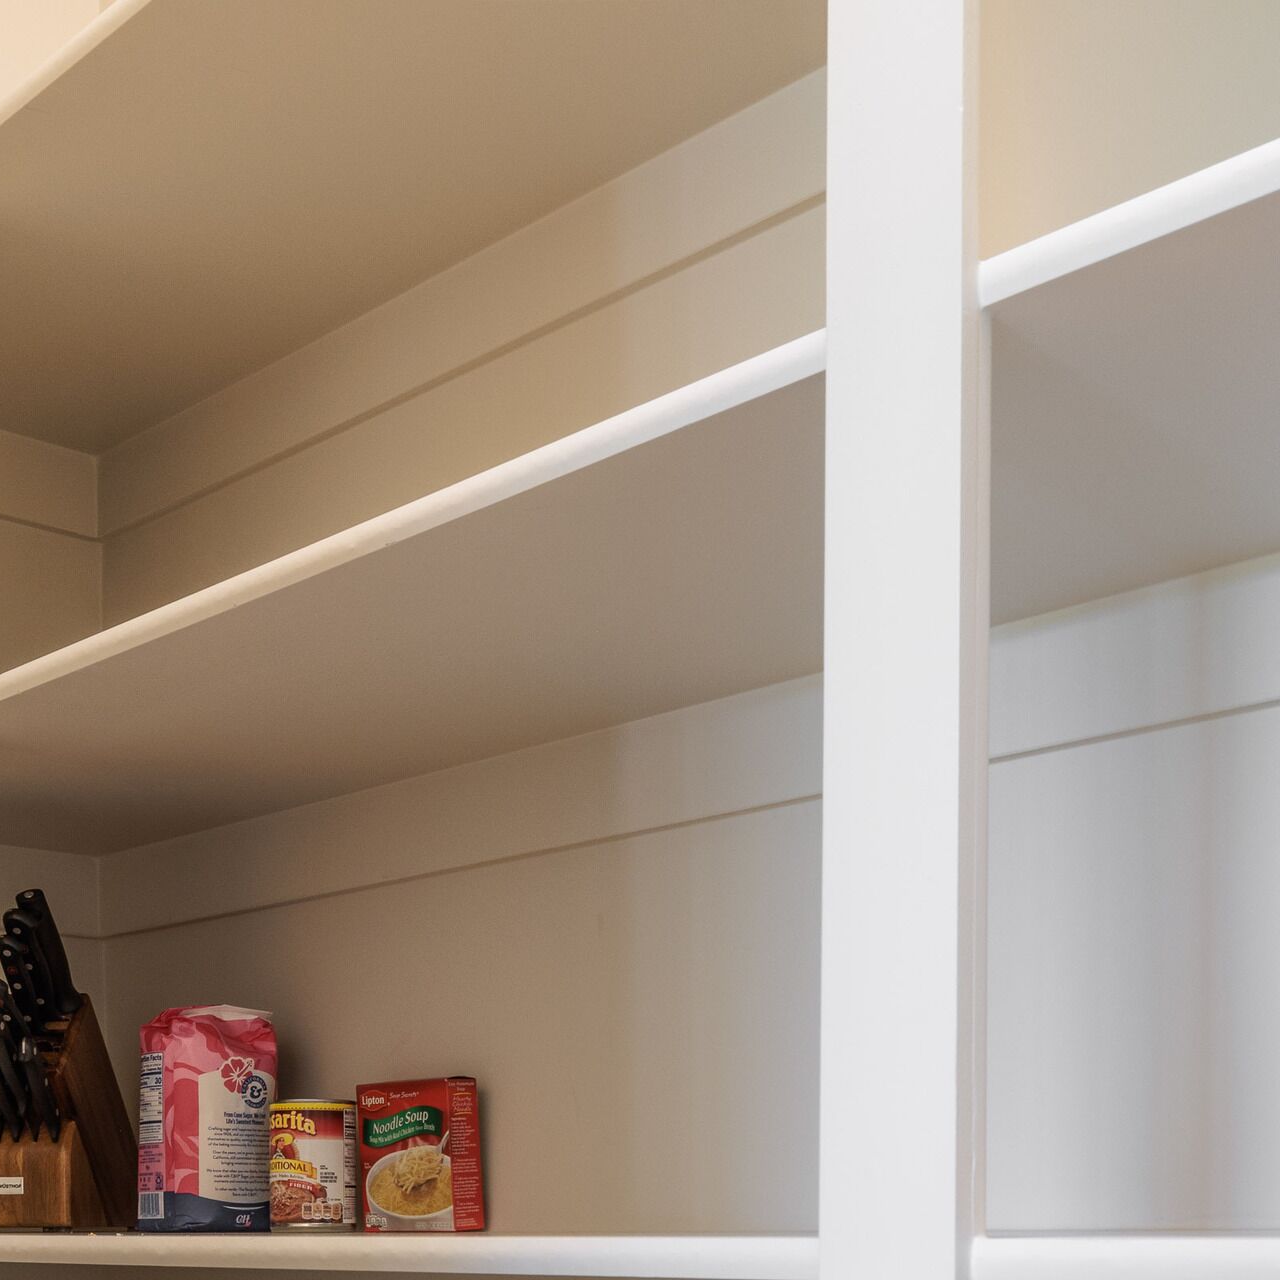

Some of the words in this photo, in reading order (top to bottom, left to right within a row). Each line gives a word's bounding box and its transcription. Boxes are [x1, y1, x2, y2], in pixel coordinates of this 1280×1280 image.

[361, 1096, 385, 1108] Lipton
[271, 1111, 316, 1135] sarita
[373, 1114, 404, 1135] Noodle
[405, 1111, 429, 1124] Soup
[271, 1161, 308, 1173] DITIONAL
